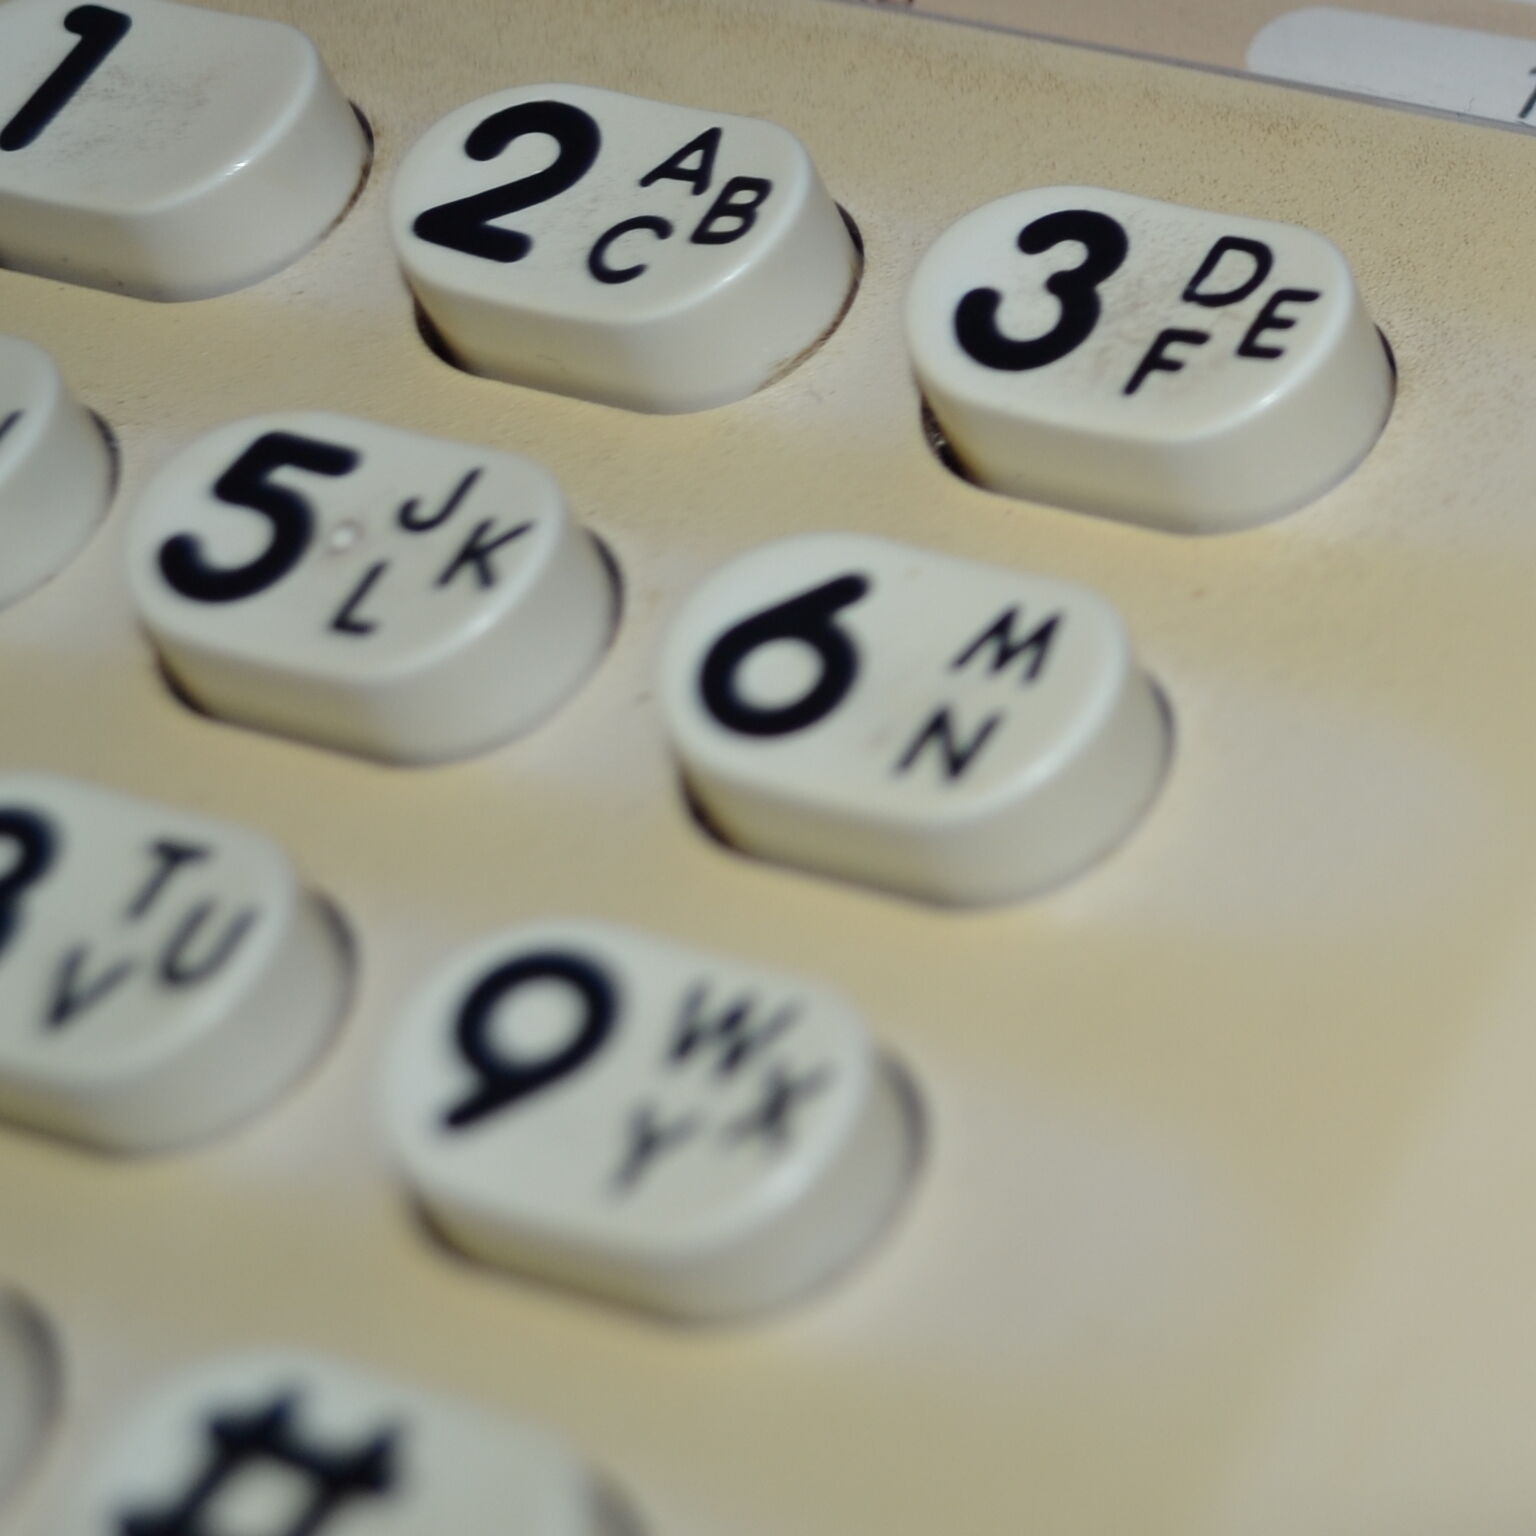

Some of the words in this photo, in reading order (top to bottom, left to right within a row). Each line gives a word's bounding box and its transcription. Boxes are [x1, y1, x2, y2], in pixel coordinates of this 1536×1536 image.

[0, 4, 132, 151] 1
[412, 100, 602, 263] 2
[953, 209, 1129, 372] 3
[156, 429, 365, 605] 5
[695, 570, 876, 740] 6
[438, 946, 624, 1136] 9
